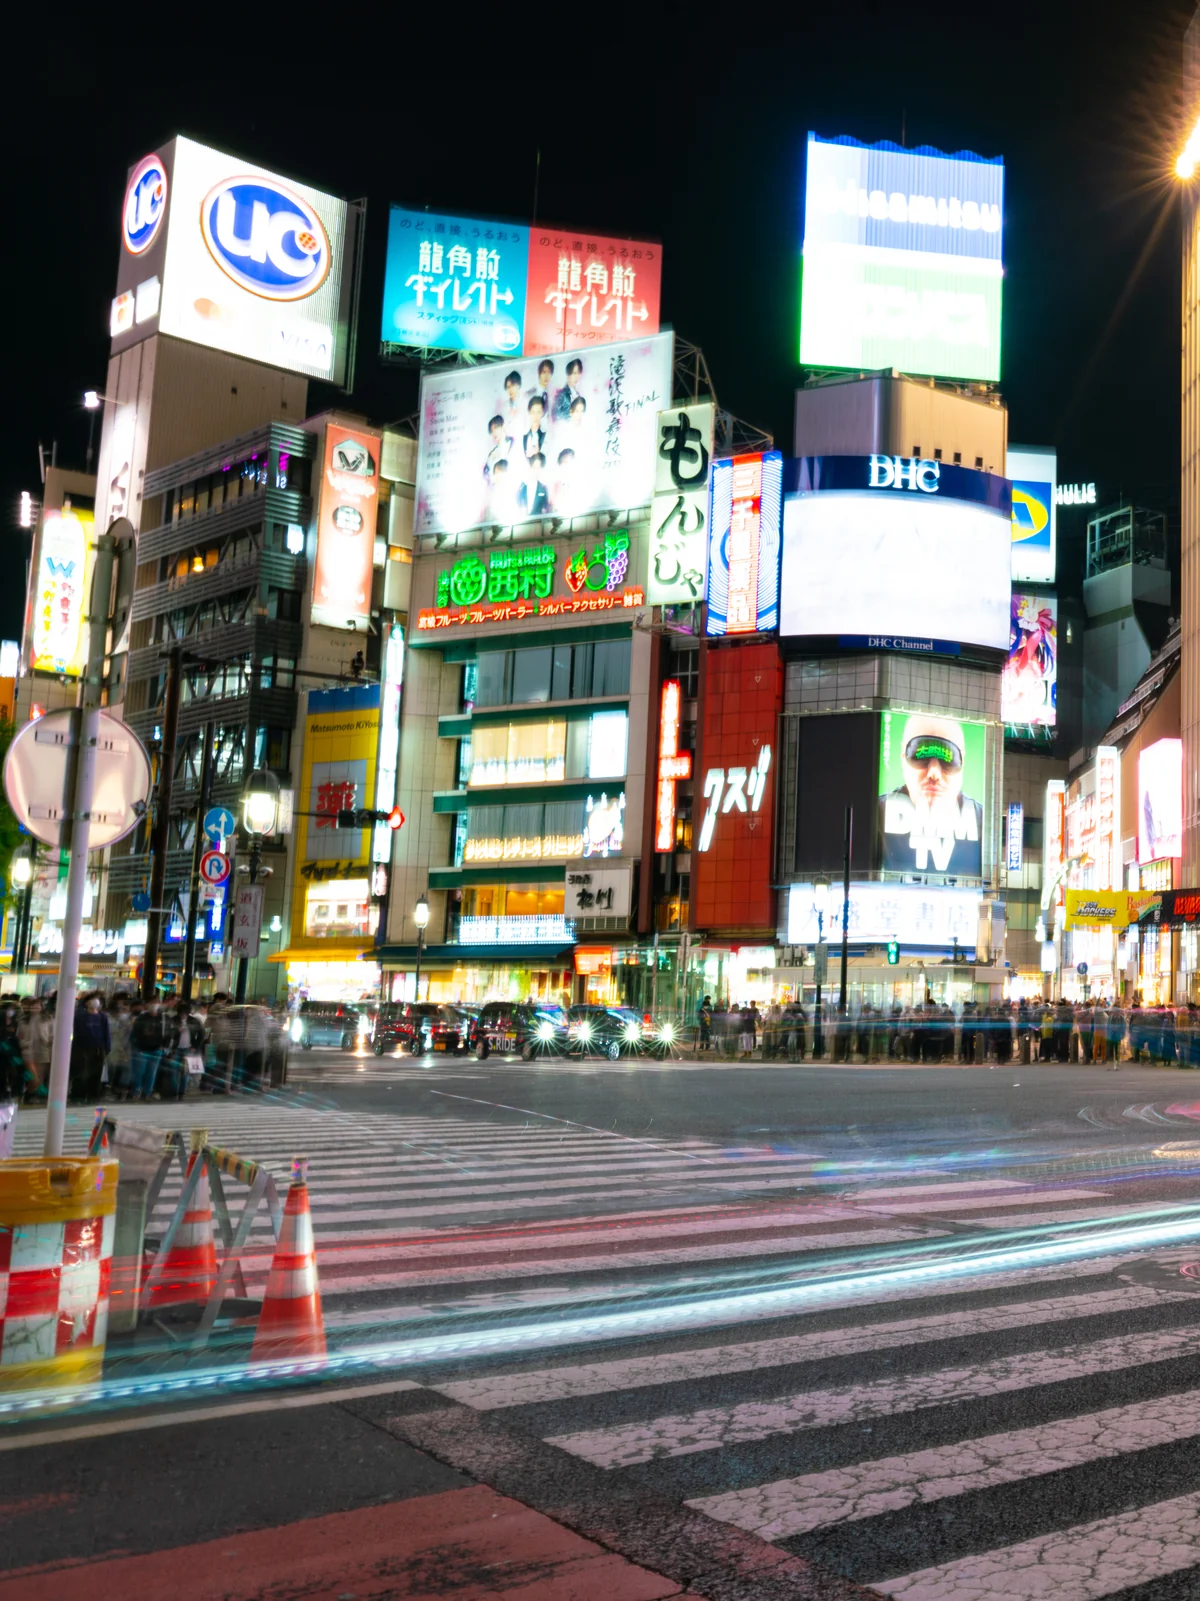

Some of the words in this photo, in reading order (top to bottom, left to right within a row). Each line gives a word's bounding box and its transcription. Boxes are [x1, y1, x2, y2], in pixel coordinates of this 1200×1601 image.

[419, 240, 500, 281] 龍角散
[557, 257, 636, 298] 龍角散
[869, 455, 940, 493] DHC
[653, 411, 710, 598] もんじゃ
[488, 567, 553, 603] 西村
[868, 637, 892, 648] DHC
[893, 638, 934, 650] Channel
[310, 723, 354, 733] Matsumoto
[909, 837, 956, 870] TV
